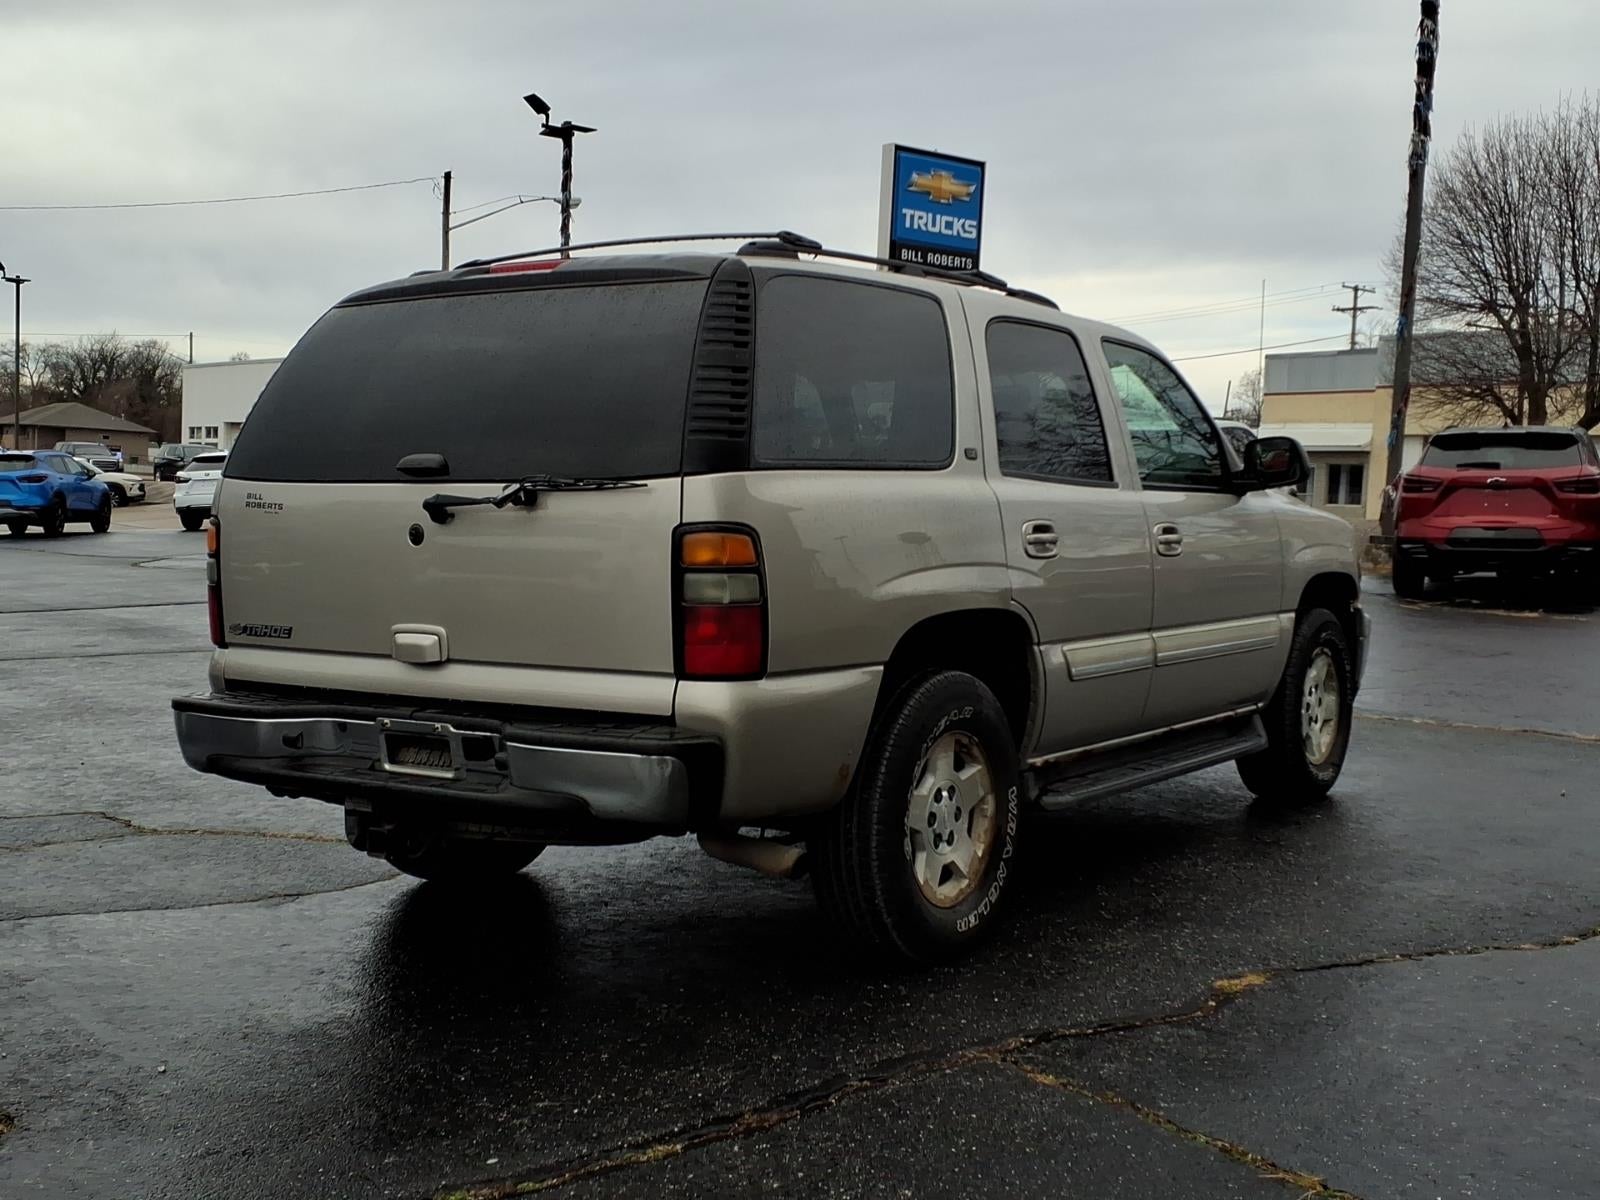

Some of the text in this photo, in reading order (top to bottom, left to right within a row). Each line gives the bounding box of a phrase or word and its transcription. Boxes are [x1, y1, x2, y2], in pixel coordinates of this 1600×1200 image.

[902, 208, 977, 239] TRUCKS
[901, 248, 973, 269] BILL ROBERTS
[246, 492, 264, 501] BILL
[245, 501, 284, 511] ROBERTS
[246, 624, 293, 639] TAHOE
